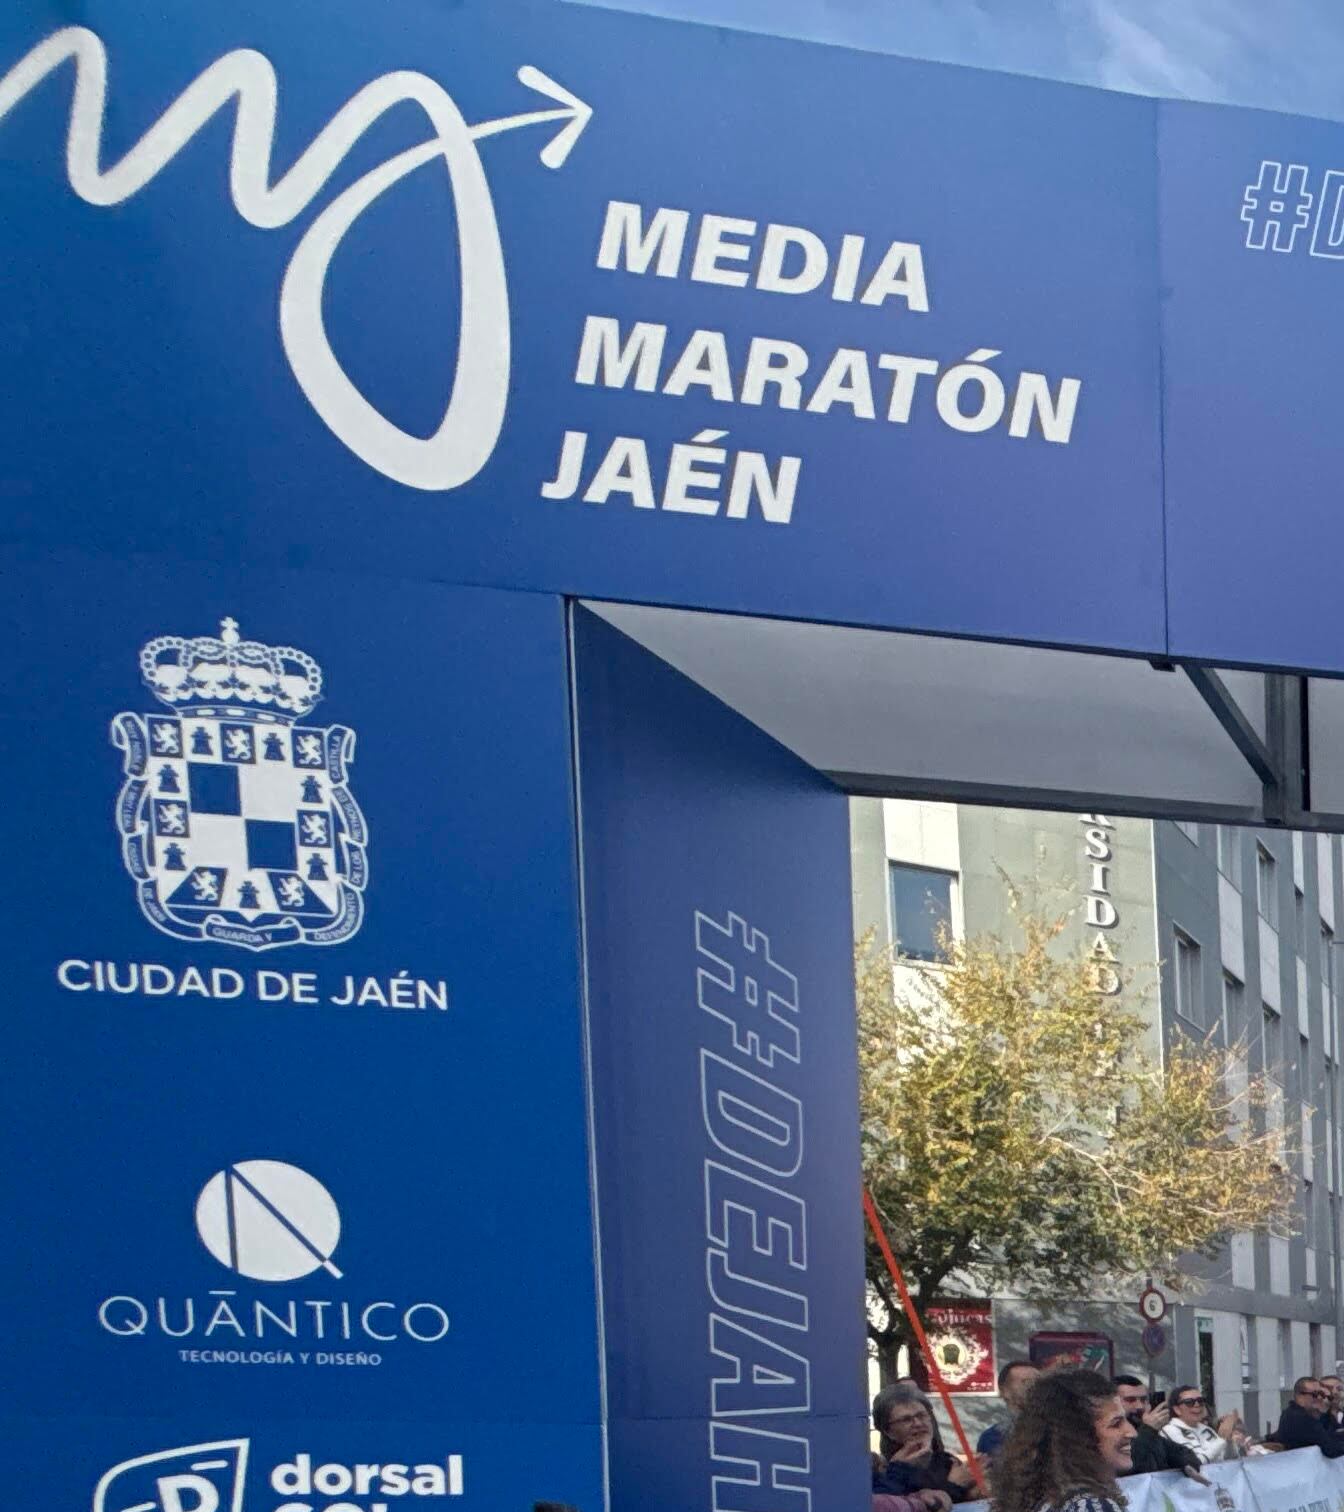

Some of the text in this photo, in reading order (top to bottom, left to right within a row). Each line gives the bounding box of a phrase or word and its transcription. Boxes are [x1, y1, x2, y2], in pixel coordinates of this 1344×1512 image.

[597, 199, 931, 314] MEDIA
[574, 316, 1081, 445] MARATÓN
[541, 430, 801, 525] JAÉN
[57, 959, 448, 1011] CIUDAD DE JAÉN
[178, 1349, 382, 1366] TECNOLOGÍA Y DISEÑO
[270, 1454, 464, 1497] dorsal
